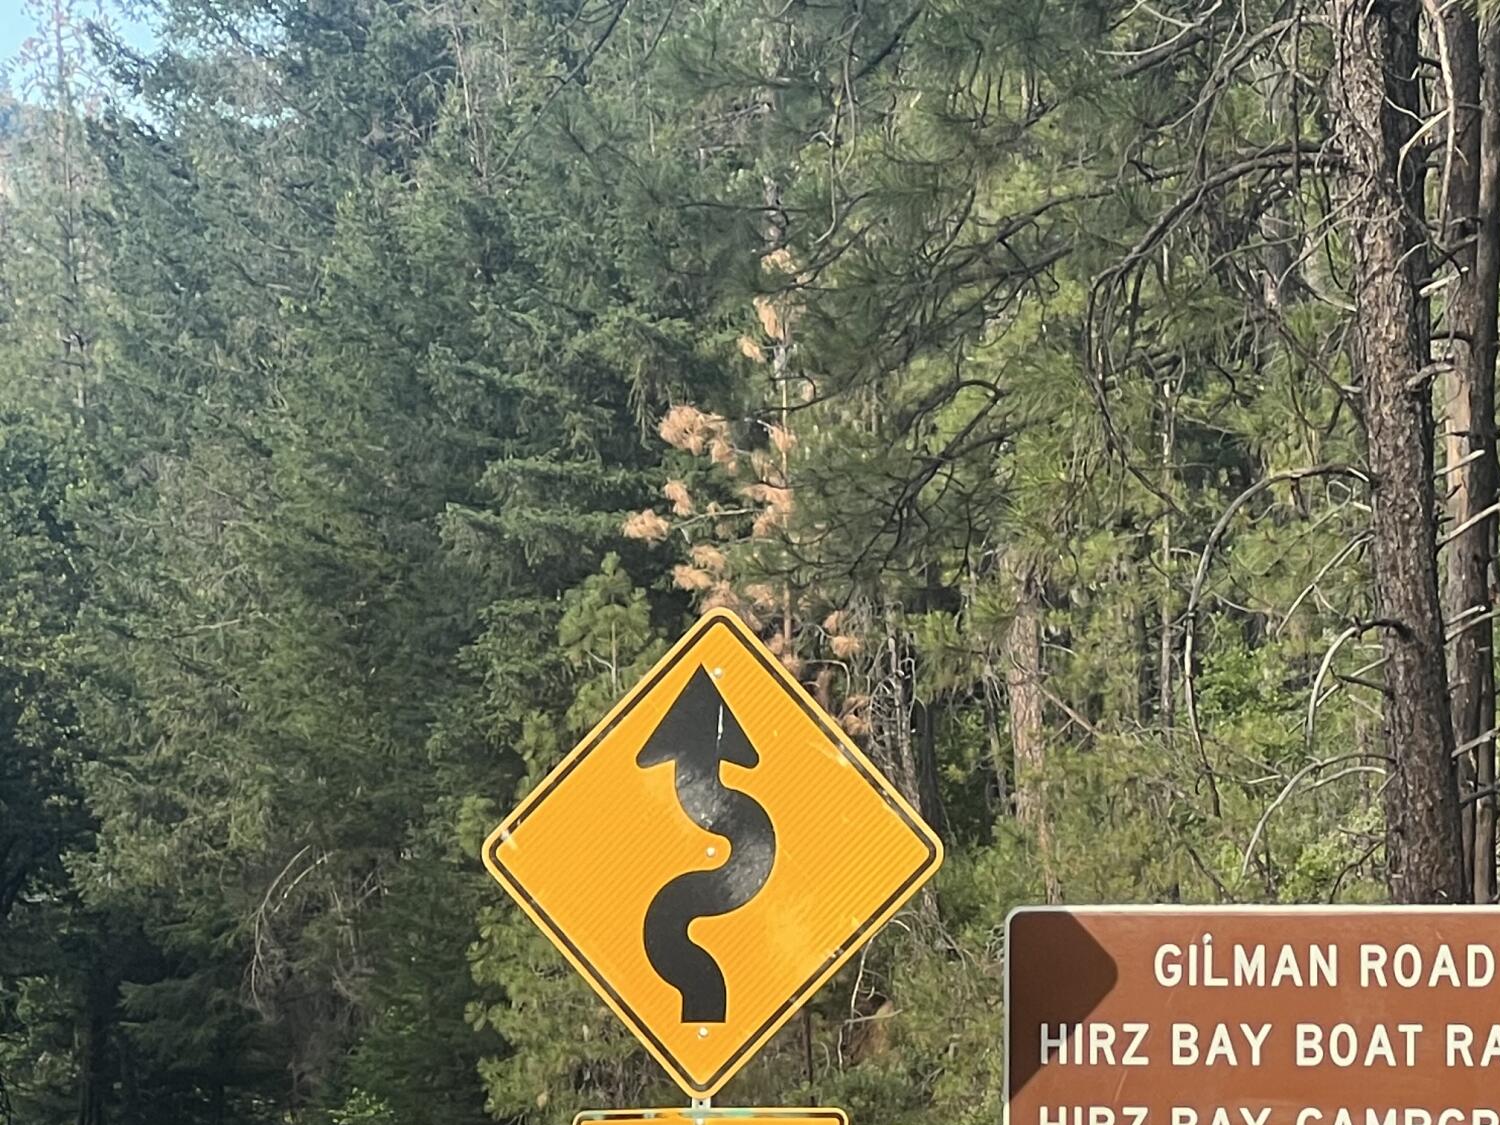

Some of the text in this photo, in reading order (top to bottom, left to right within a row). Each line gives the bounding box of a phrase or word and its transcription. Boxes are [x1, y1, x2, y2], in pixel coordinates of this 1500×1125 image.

[1154, 941, 1337, 987] GILMAN
[1360, 944, 1494, 987] ROAD
[1042, 1023, 1149, 1065] HIRZ
[1173, 1023, 1272, 1066] BAY
[1296, 1023, 1423, 1066] BOAT
